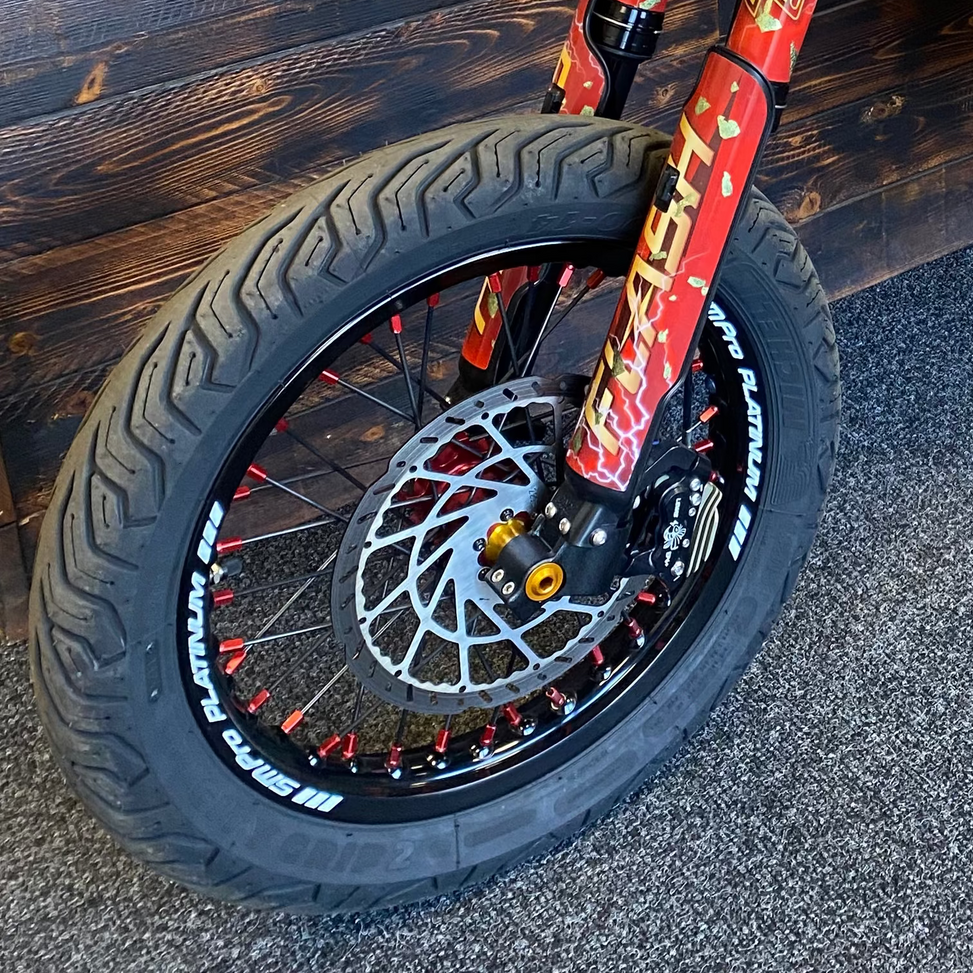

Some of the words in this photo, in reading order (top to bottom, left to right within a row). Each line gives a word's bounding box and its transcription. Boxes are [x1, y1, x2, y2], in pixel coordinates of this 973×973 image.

[583, 113, 713, 456] FLASH
[738, 368, 763, 502] PLATINUM
[187, 571, 227, 723] PLATINUM
